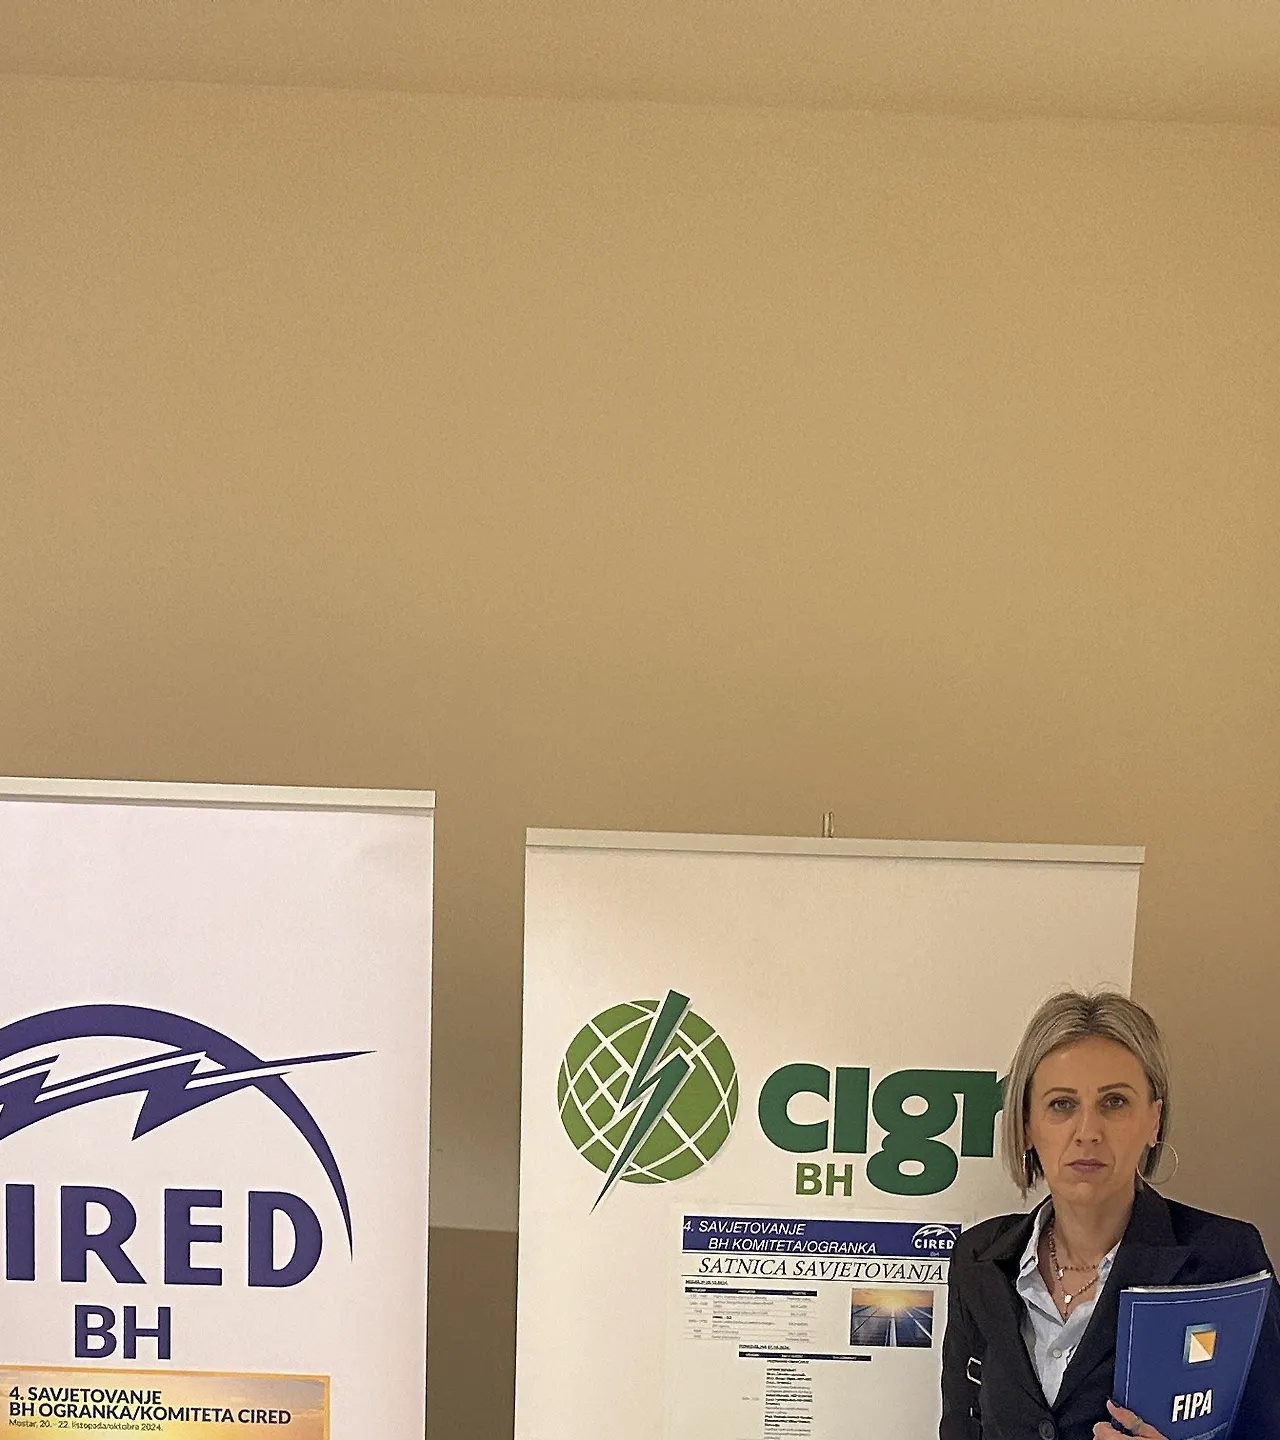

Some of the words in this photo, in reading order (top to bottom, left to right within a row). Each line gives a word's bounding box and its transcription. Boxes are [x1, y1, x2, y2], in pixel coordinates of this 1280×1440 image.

[796, 1162, 853, 1197] BH
[683, 1221, 695, 1233] 4.
[698, 1220, 806, 1236] SAVJETOVANJE
[708, 1238, 728, 1250] BH
[732, 1238, 877, 1254] KOMITETA/OGRANKA
[914, 1239, 955, 1249] CIRED
[698, 1257, 787, 1276] SATNICA
[792, 1260, 943, 1283] SAVJETOVANJA
[74, 1303, 172, 1361] BH
[9, 1386, 24, 1401] 4.
[28, 1387, 162, 1404] SAVJETOVANJE
[1171, 1389, 1213, 1422] FIPA
[9, 1402, 34, 1417] BH
[39, 1403, 234, 1424] OGRANKA/KOMITETA
[238, 1409, 292, 1425] CIRED
